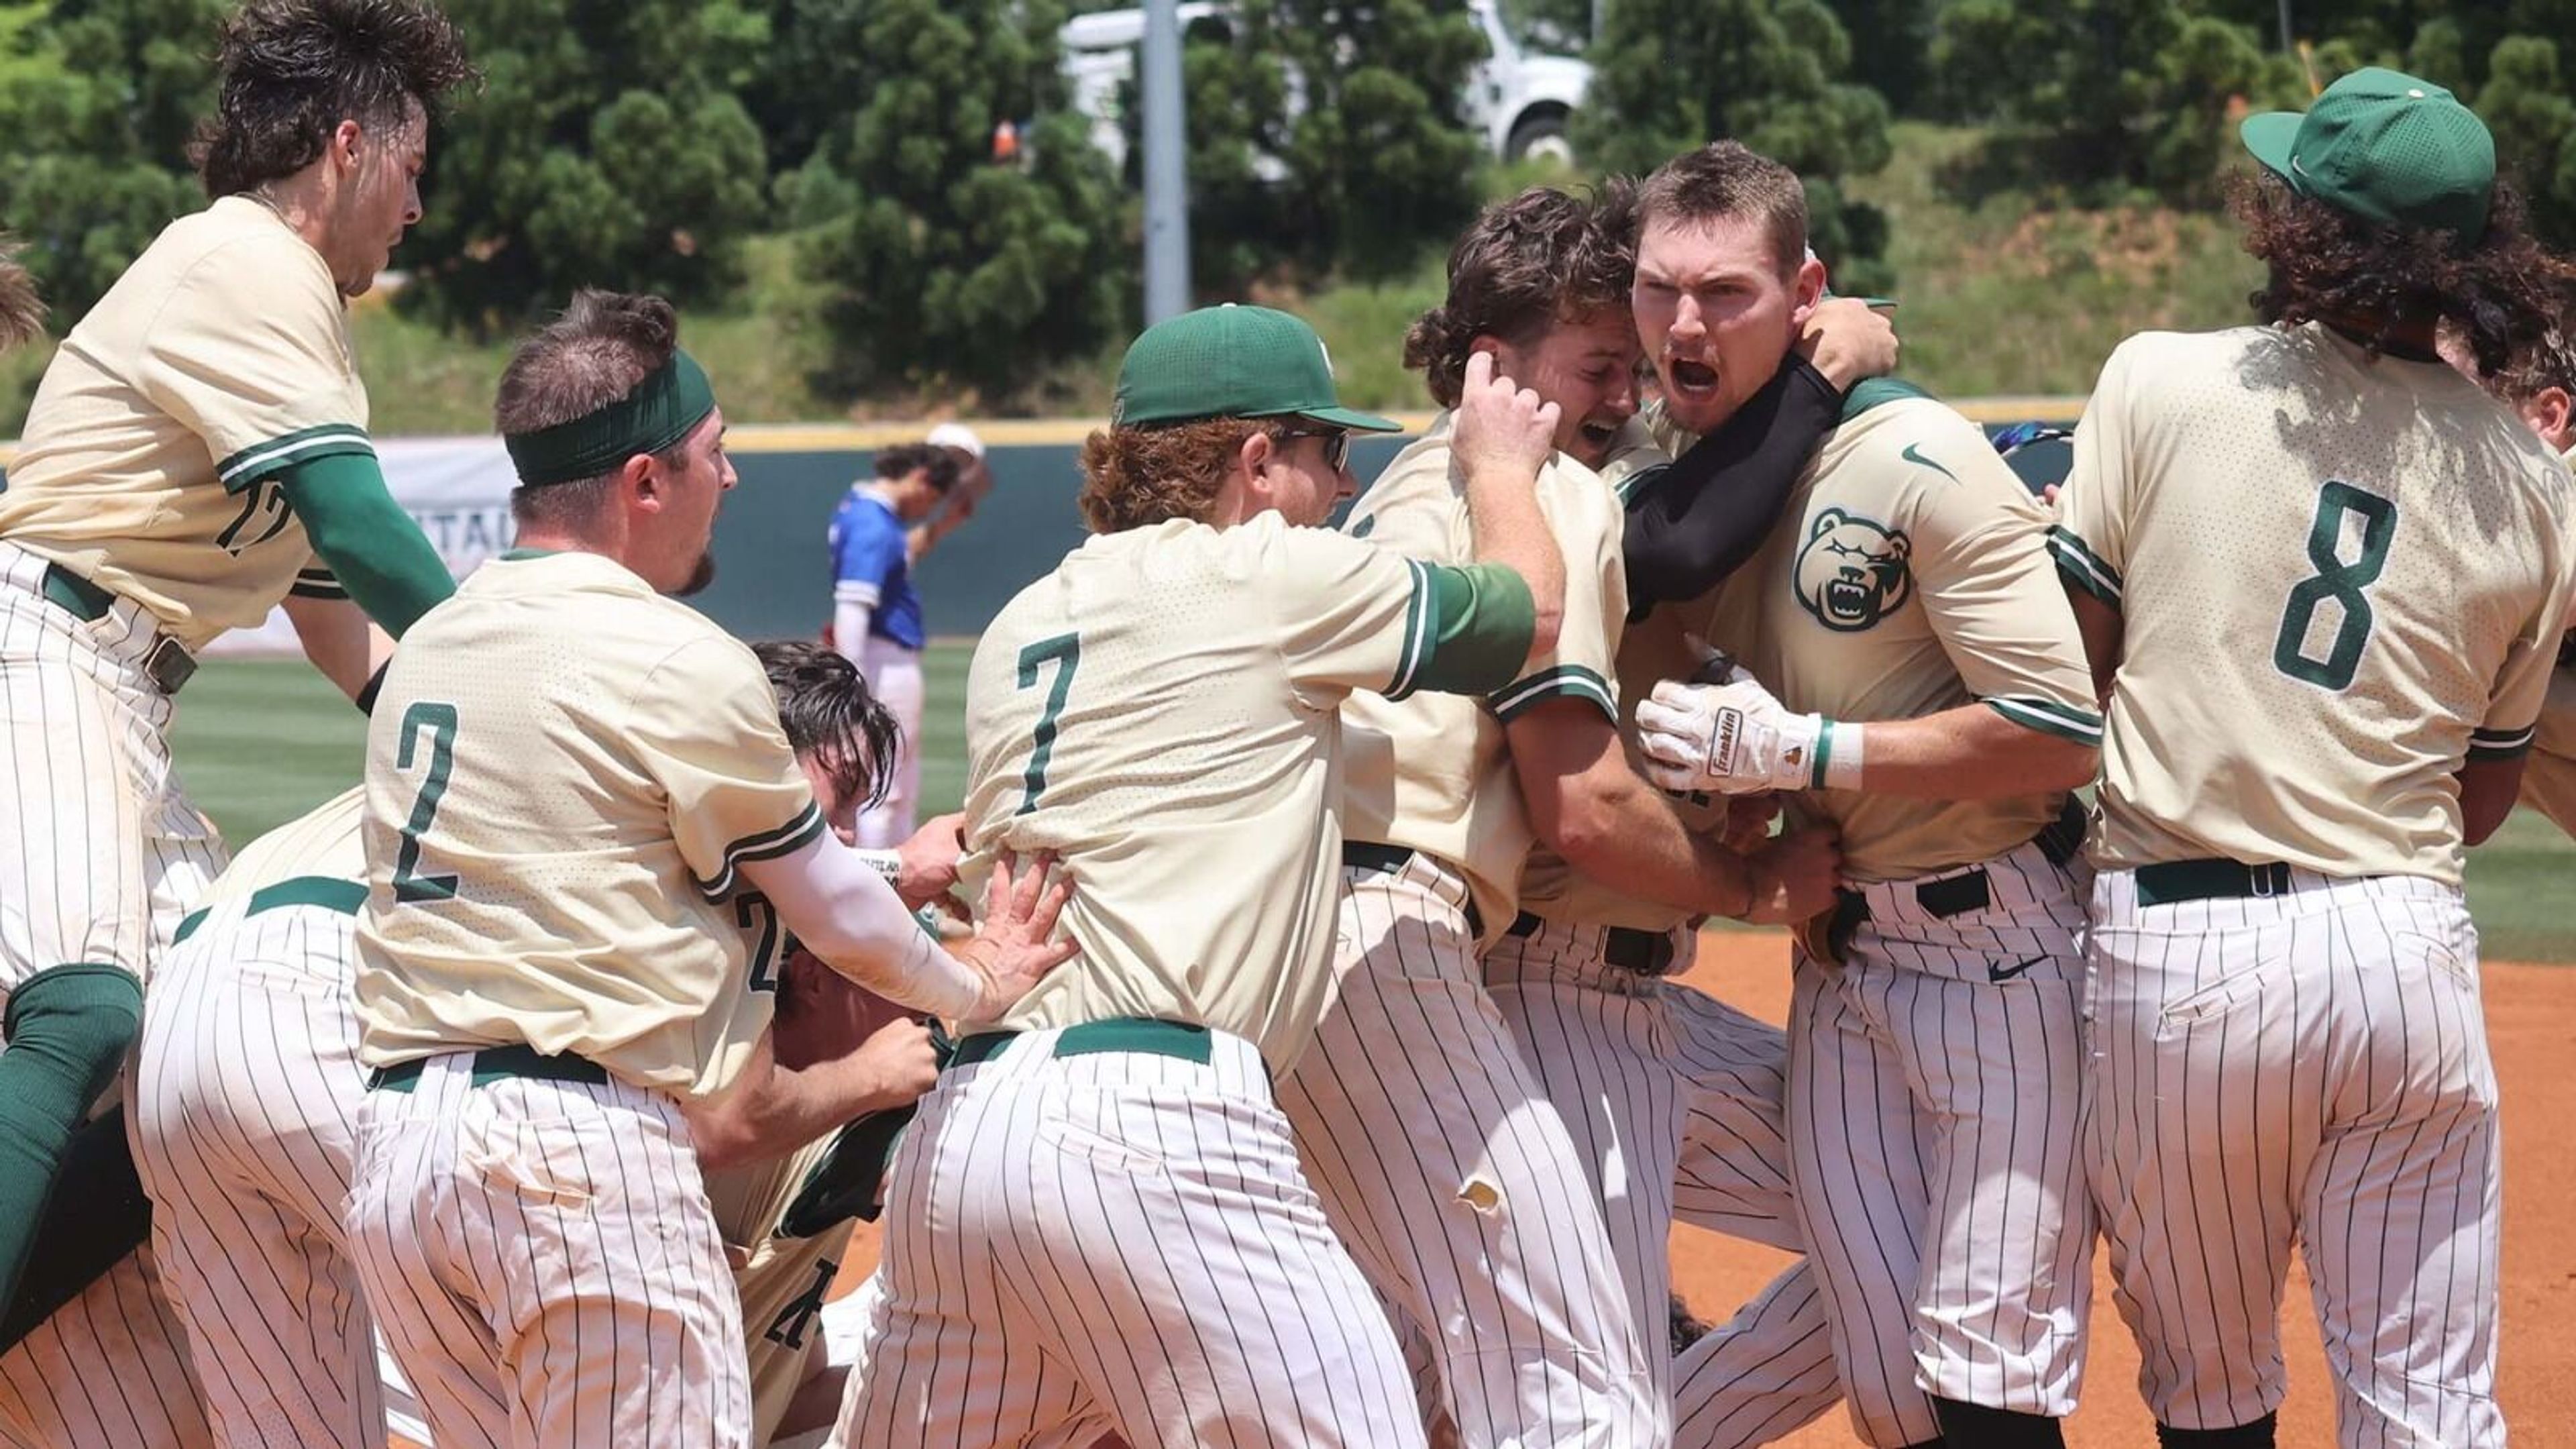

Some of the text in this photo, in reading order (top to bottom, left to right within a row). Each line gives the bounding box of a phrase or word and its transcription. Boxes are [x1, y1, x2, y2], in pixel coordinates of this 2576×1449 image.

[2272, 479, 2400, 692] 8
[391, 700, 460, 904] 2
[1013, 631, 1081, 817] 7
[1712, 711, 1736, 773] Franklin
[735, 890, 778, 993] 2
